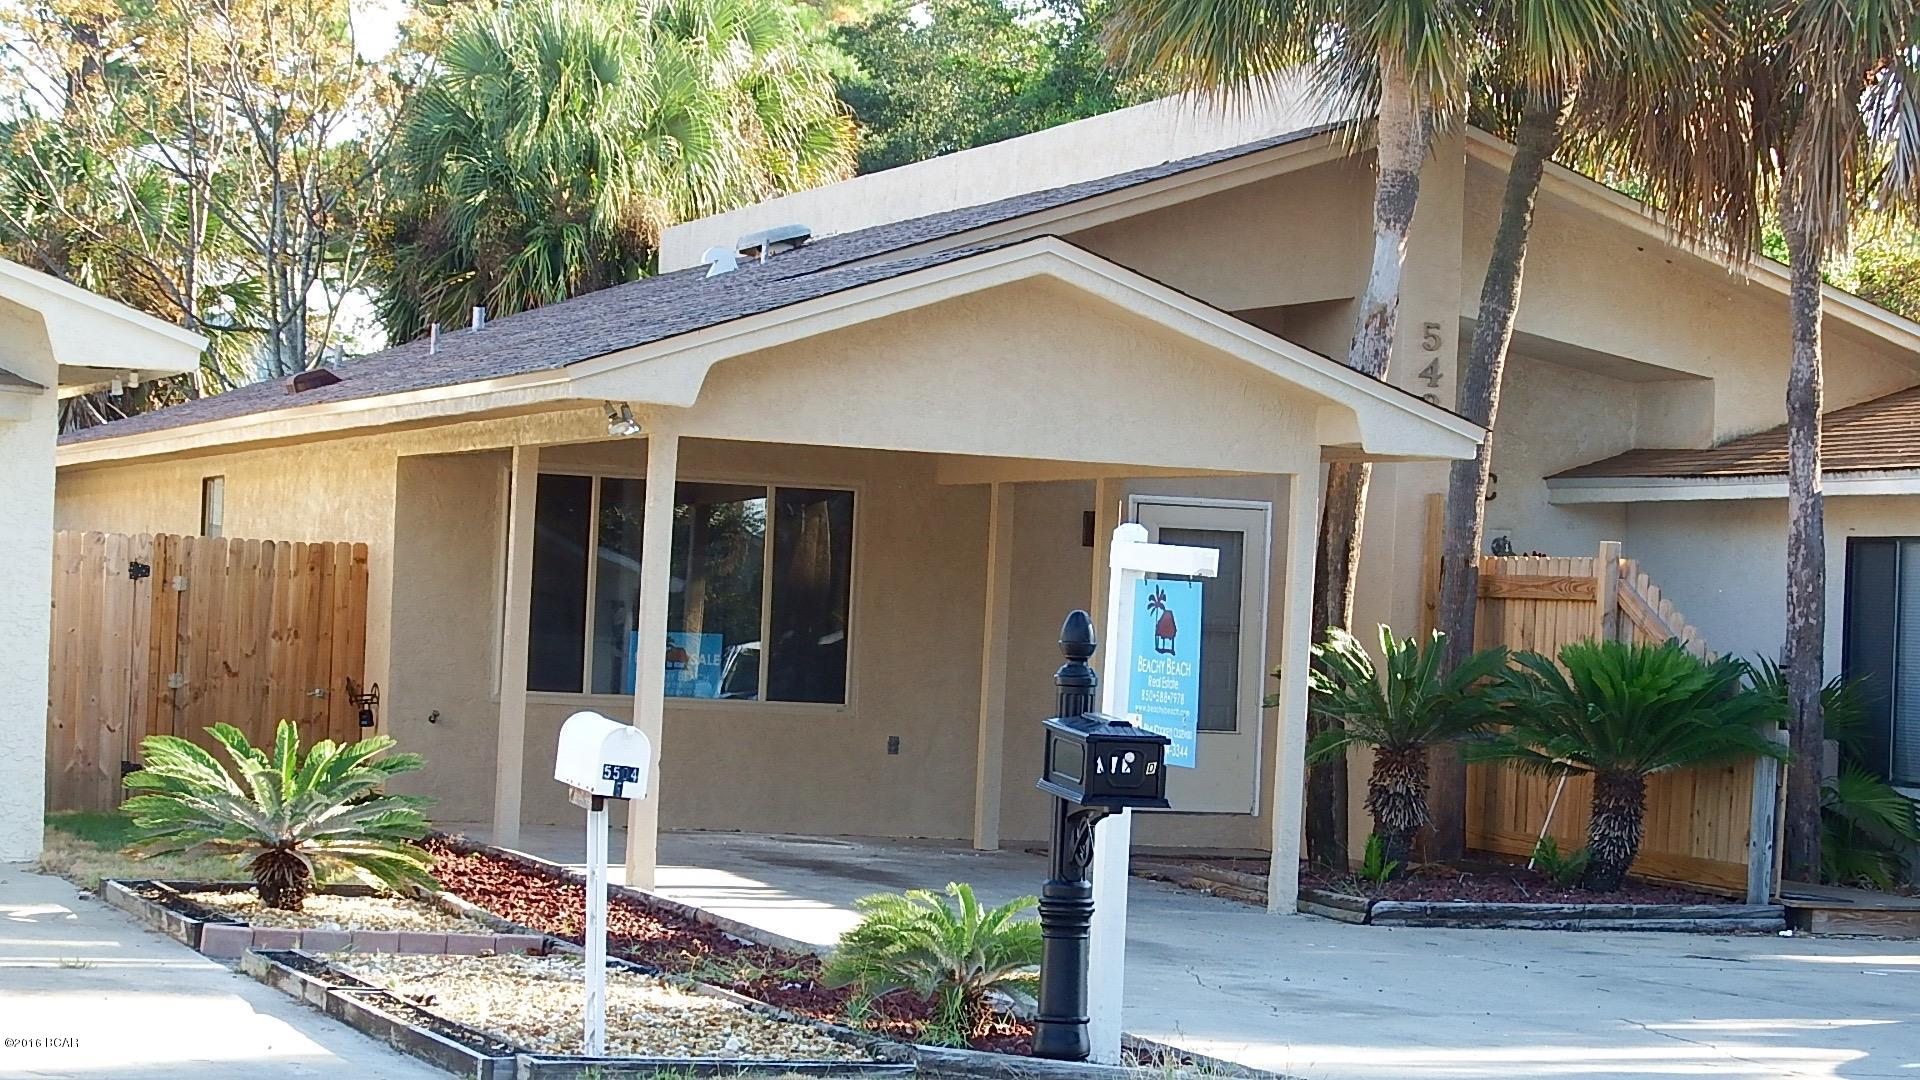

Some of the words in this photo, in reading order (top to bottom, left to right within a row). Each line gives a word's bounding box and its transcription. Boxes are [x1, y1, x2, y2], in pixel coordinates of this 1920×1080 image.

[1138, 655, 1165, 674] BEACHY
[1166, 657, 1191, 677] BEACH
[1148, 675, 1161, 688] Real
[1161, 676, 1179, 690] Estate
